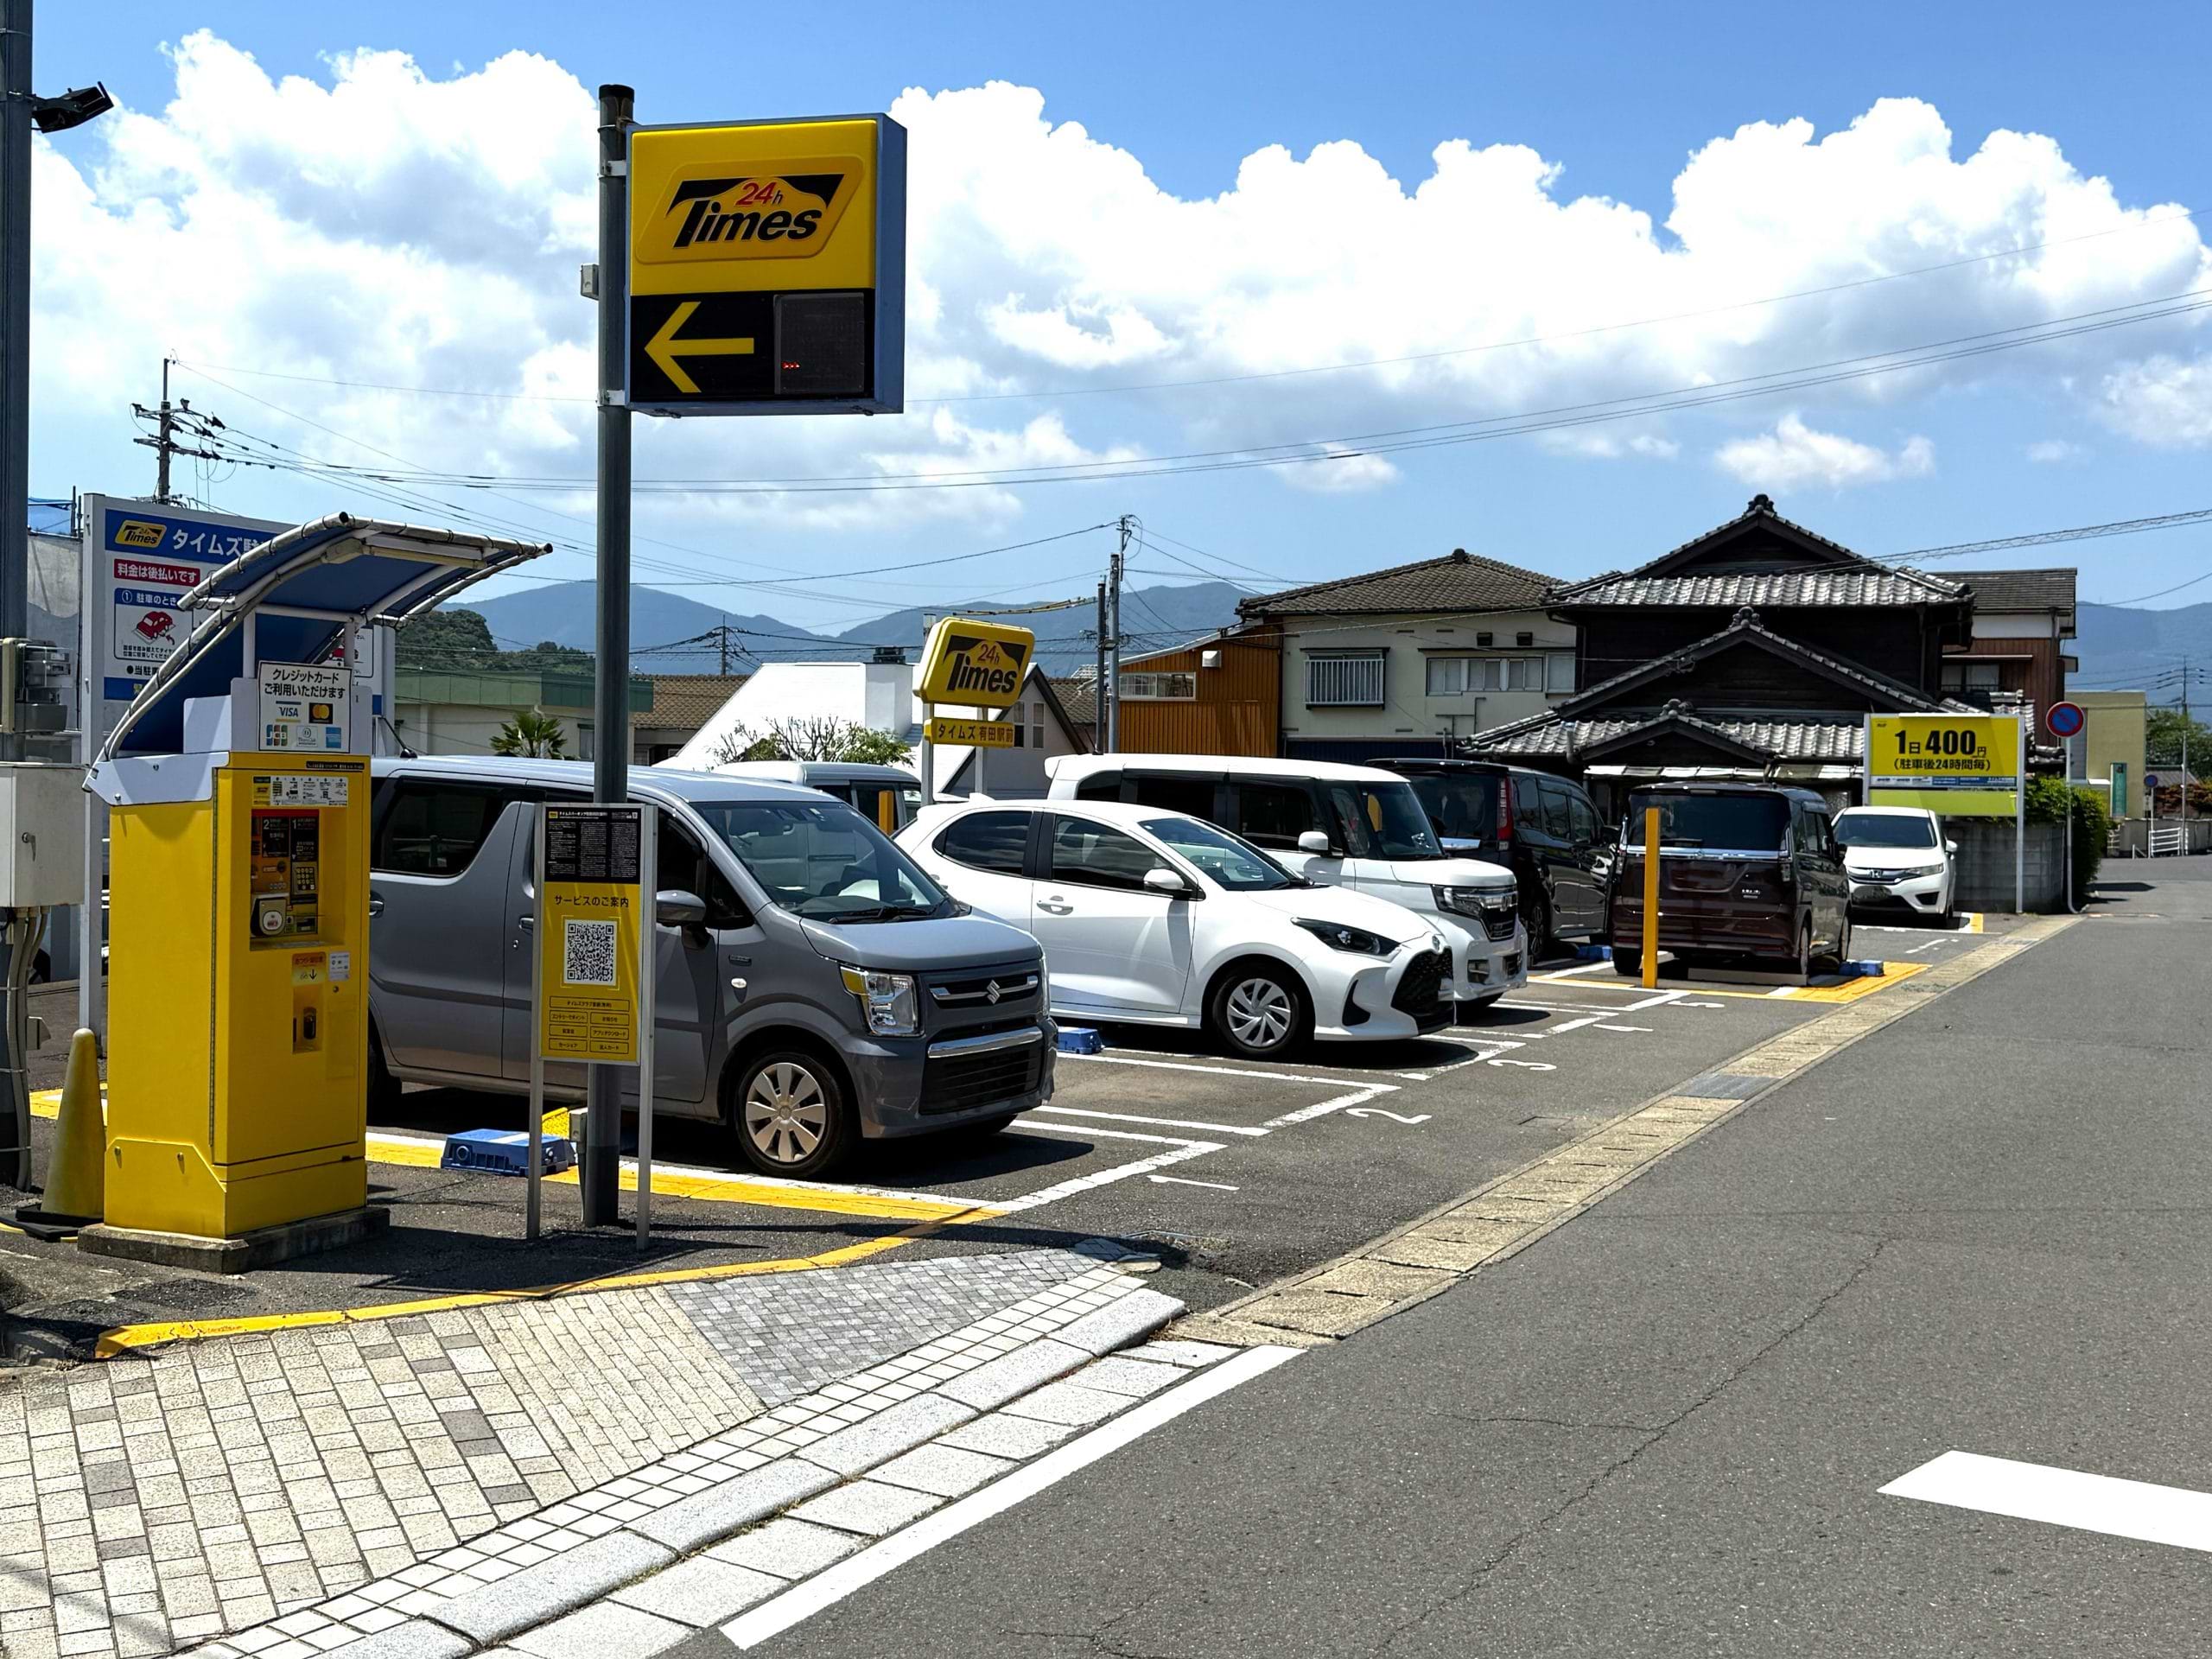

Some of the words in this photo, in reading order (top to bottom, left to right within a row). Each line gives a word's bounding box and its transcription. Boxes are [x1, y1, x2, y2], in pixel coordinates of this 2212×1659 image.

[734, 181, 783, 207] 24h
[669, 187, 826, 249] Times
[124, 528, 159, 544] Times
[118, 563, 197, 584] 料金は後払いです
[976, 643, 1000, 664] 24h
[272, 669, 340, 684] クレジットカード
[945, 646, 1020, 693] Times
[264, 683, 346, 699] ご利用いただけます
[278, 707, 299, 717] VISA
[555, 894, 629, 908] サービスのご案内
[1344, 1108, 1432, 1124] 2
